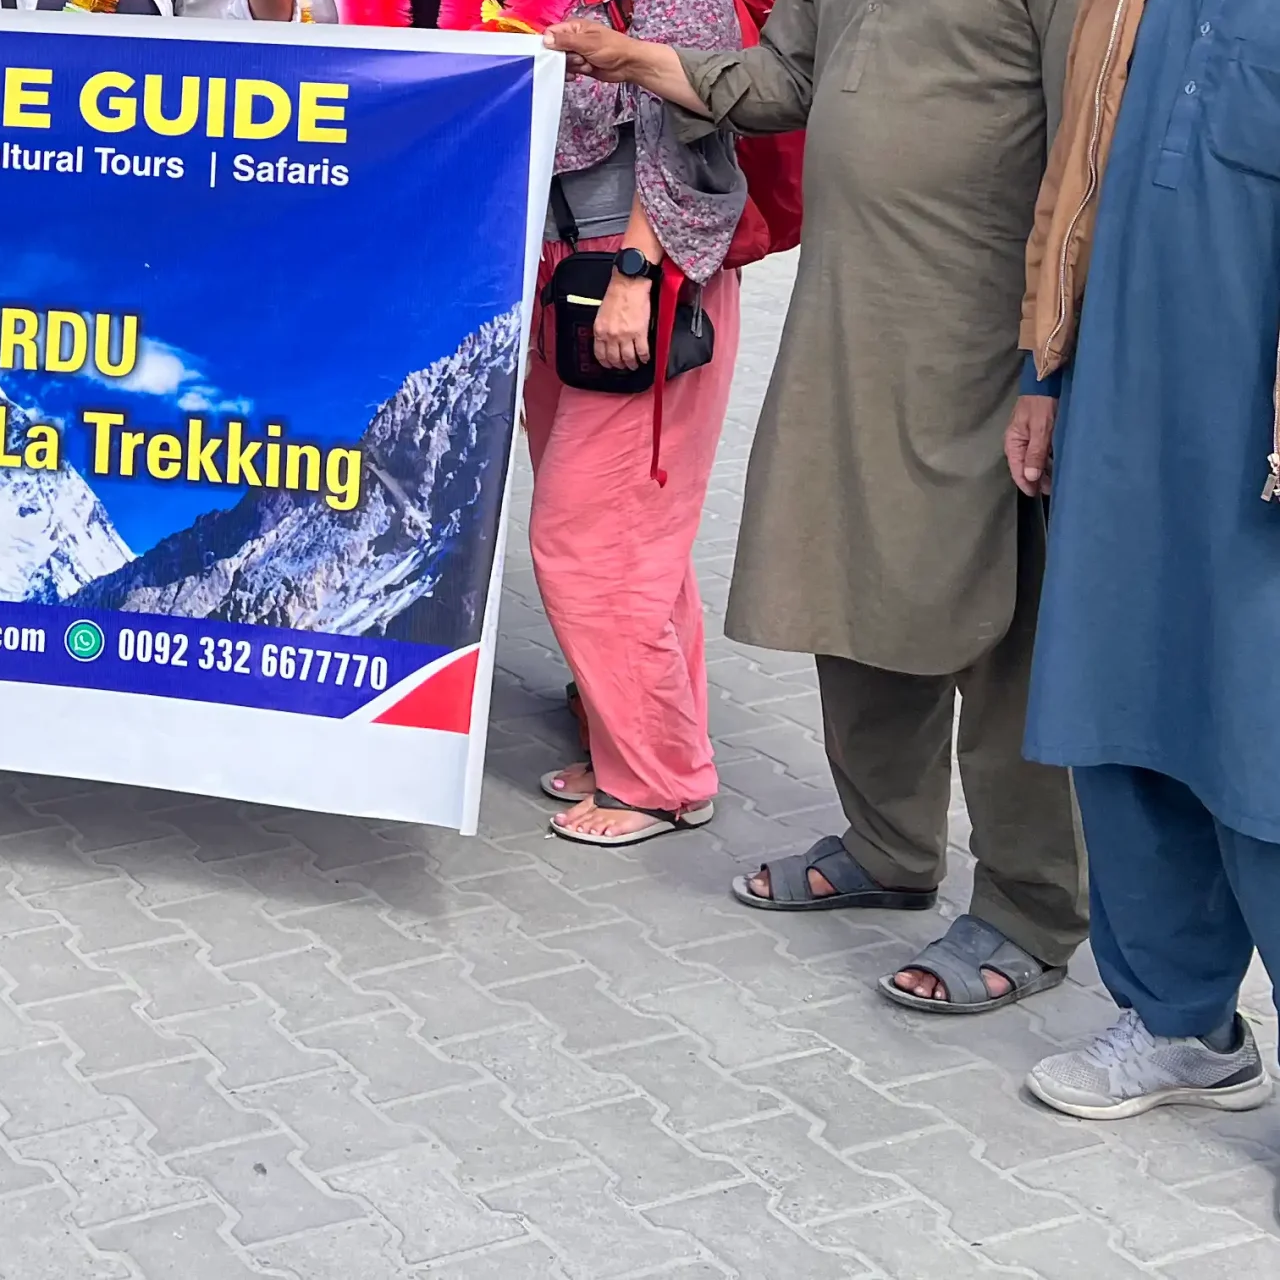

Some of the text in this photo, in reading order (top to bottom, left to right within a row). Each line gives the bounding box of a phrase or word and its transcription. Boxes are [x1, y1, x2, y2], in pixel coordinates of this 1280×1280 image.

[80, 72, 348, 143] GUIDE
[94, 147, 184, 178] Tours
[233, 154, 349, 186] Safaris
[84, 412, 362, 510] Trekking
[117, 627, 390, 693] 0092 332 6677770
